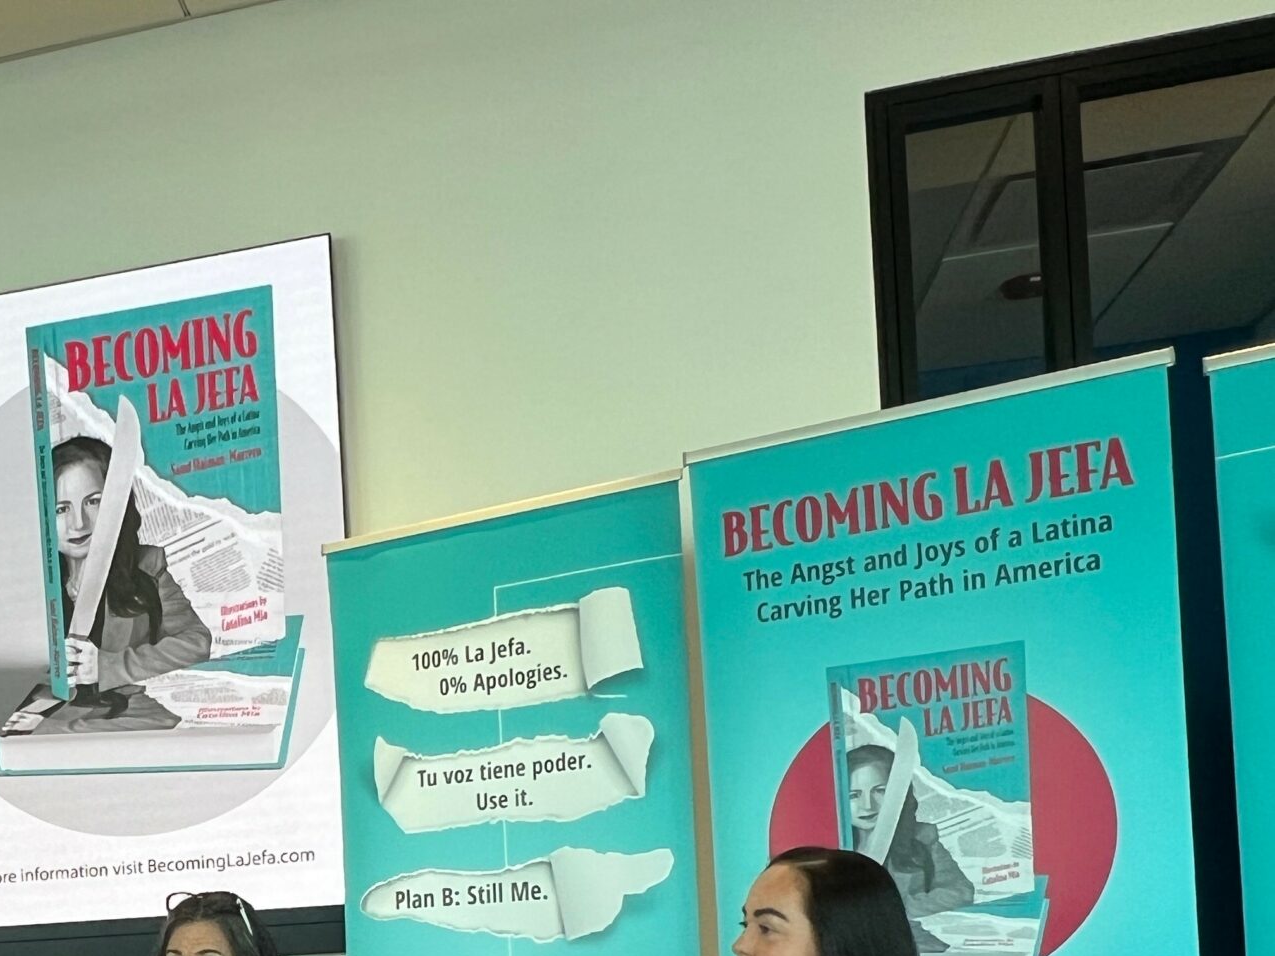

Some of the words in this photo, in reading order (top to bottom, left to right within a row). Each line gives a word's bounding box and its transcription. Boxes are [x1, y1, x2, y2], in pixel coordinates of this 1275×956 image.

[65, 309, 257, 392] BECOMING
[147, 378, 186, 423] LA
[194, 364, 259, 414] JEFA
[724, 472, 943, 557] BECOMING
[954, 460, 1014, 515] LA
[1025, 437, 1134, 503] JEFA
[743, 569, 782, 591] The
[791, 556, 855, 585] Angst
[864, 544, 907, 572] and
[914, 540, 965, 569] Joys
[975, 528, 1000, 553] of
[1008, 530, 1021, 548] a
[1032, 514, 1112, 543] Latina
[757, 595, 842, 622] Carving
[851, 587, 890, 609] Her
[900, 573, 953, 601] Path
[963, 570, 985, 591] in
[995, 552, 1100, 586] America
[411, 648, 458, 671] 100%
[465, 646, 484, 663] La
[489, 637, 531, 664] Jefa.
[440, 676, 467, 696] 0%
[473, 664, 567, 695] Apologies.
[858, 657, 1012, 713] BECOMING
[923, 705, 955, 736] LA
[961, 696, 1012, 731] JEFA
[417, 770, 437, 788] Tu
[443, 769, 473, 784] voz
[480, 762, 525, 781] tiene
[533, 752, 591, 780] poder.
[477, 793, 508, 810] Use
[515, 788, 533, 807] it.
[21, 864, 108, 882] information
[113, 860, 143, 875] visit
[148, 850, 315, 873] BecomingLaJefa.com
[396, 889, 434, 910] Plan
[442, 888, 460, 906] B:
[467, 882, 503, 905] Still
[511, 882, 548, 902] Me.
